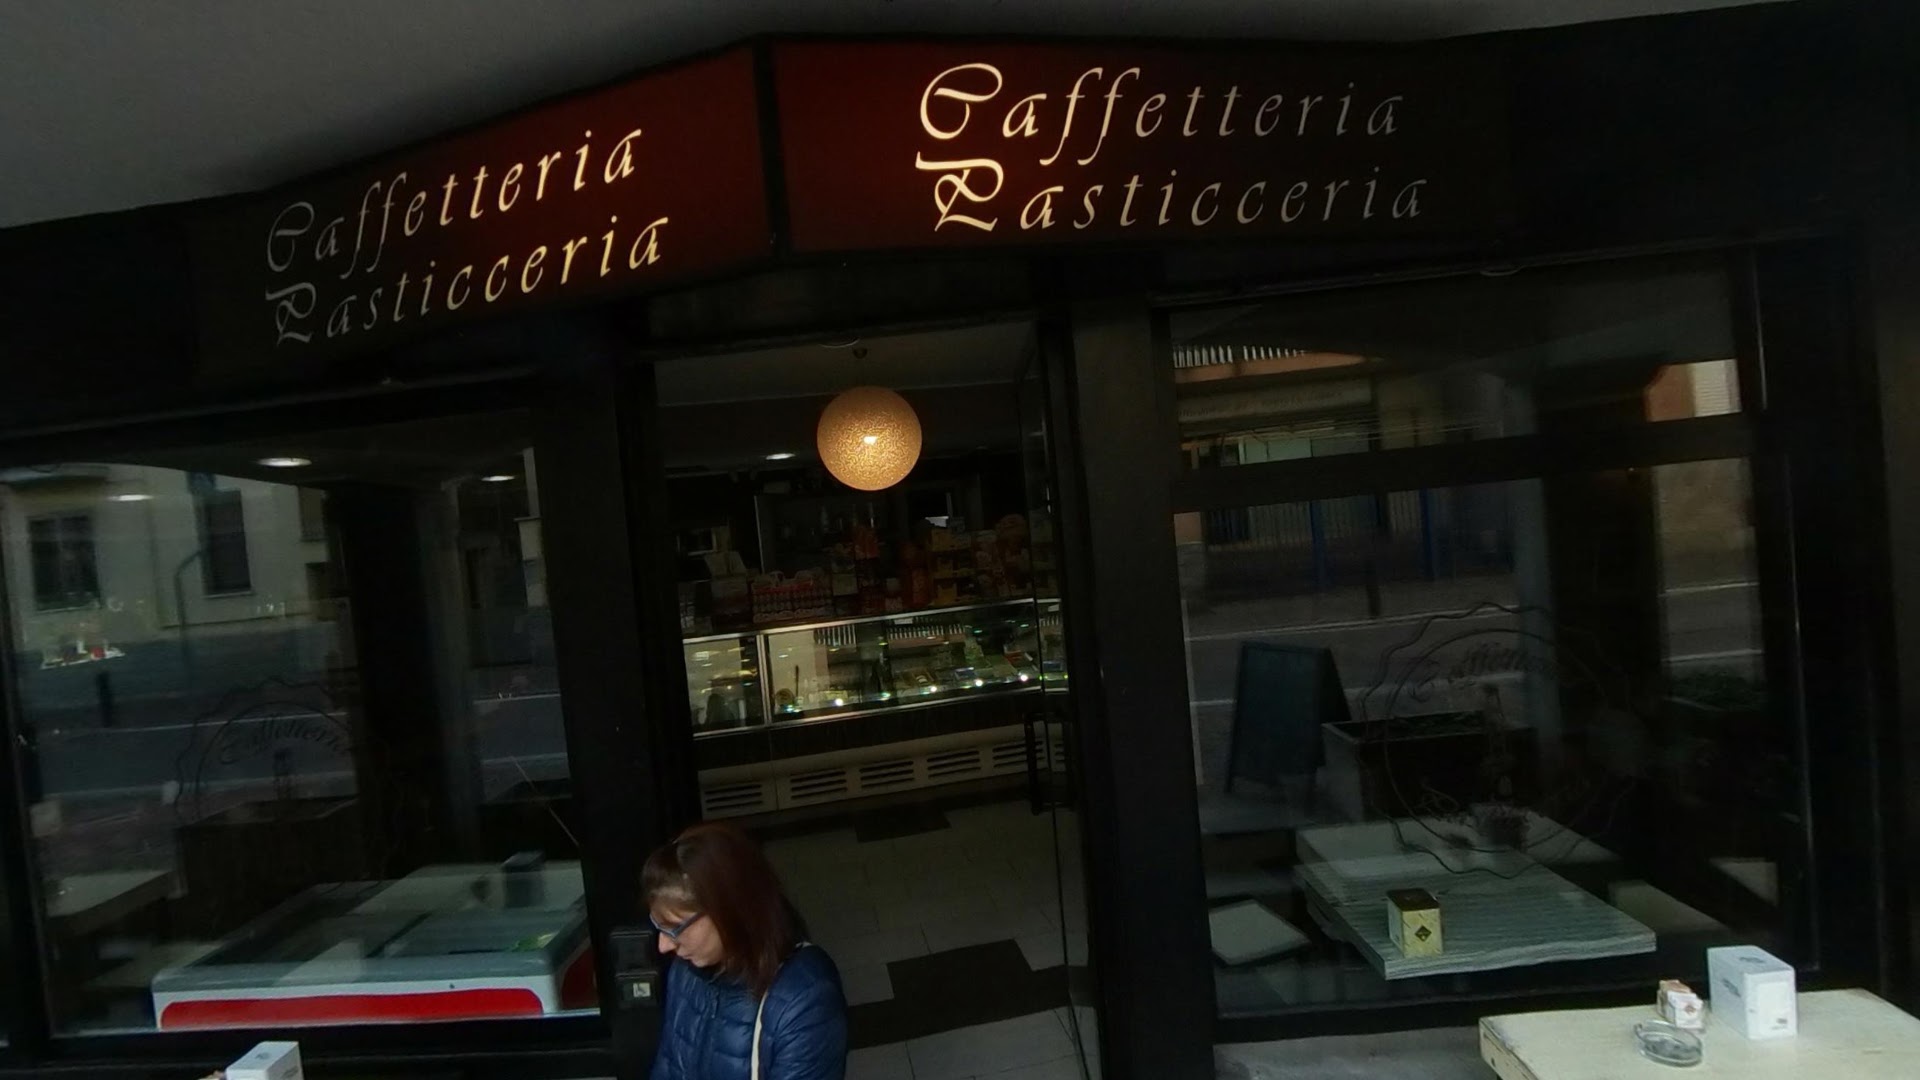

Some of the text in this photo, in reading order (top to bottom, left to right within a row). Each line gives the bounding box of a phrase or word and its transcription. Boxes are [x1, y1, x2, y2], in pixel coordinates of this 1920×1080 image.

[920, 61, 1404, 167] Caffetteria
[265, 128, 643, 280] Caffetteria
[914, 151, 1429, 232] Pasticceria
[264, 215, 671, 346] Pasticceria
